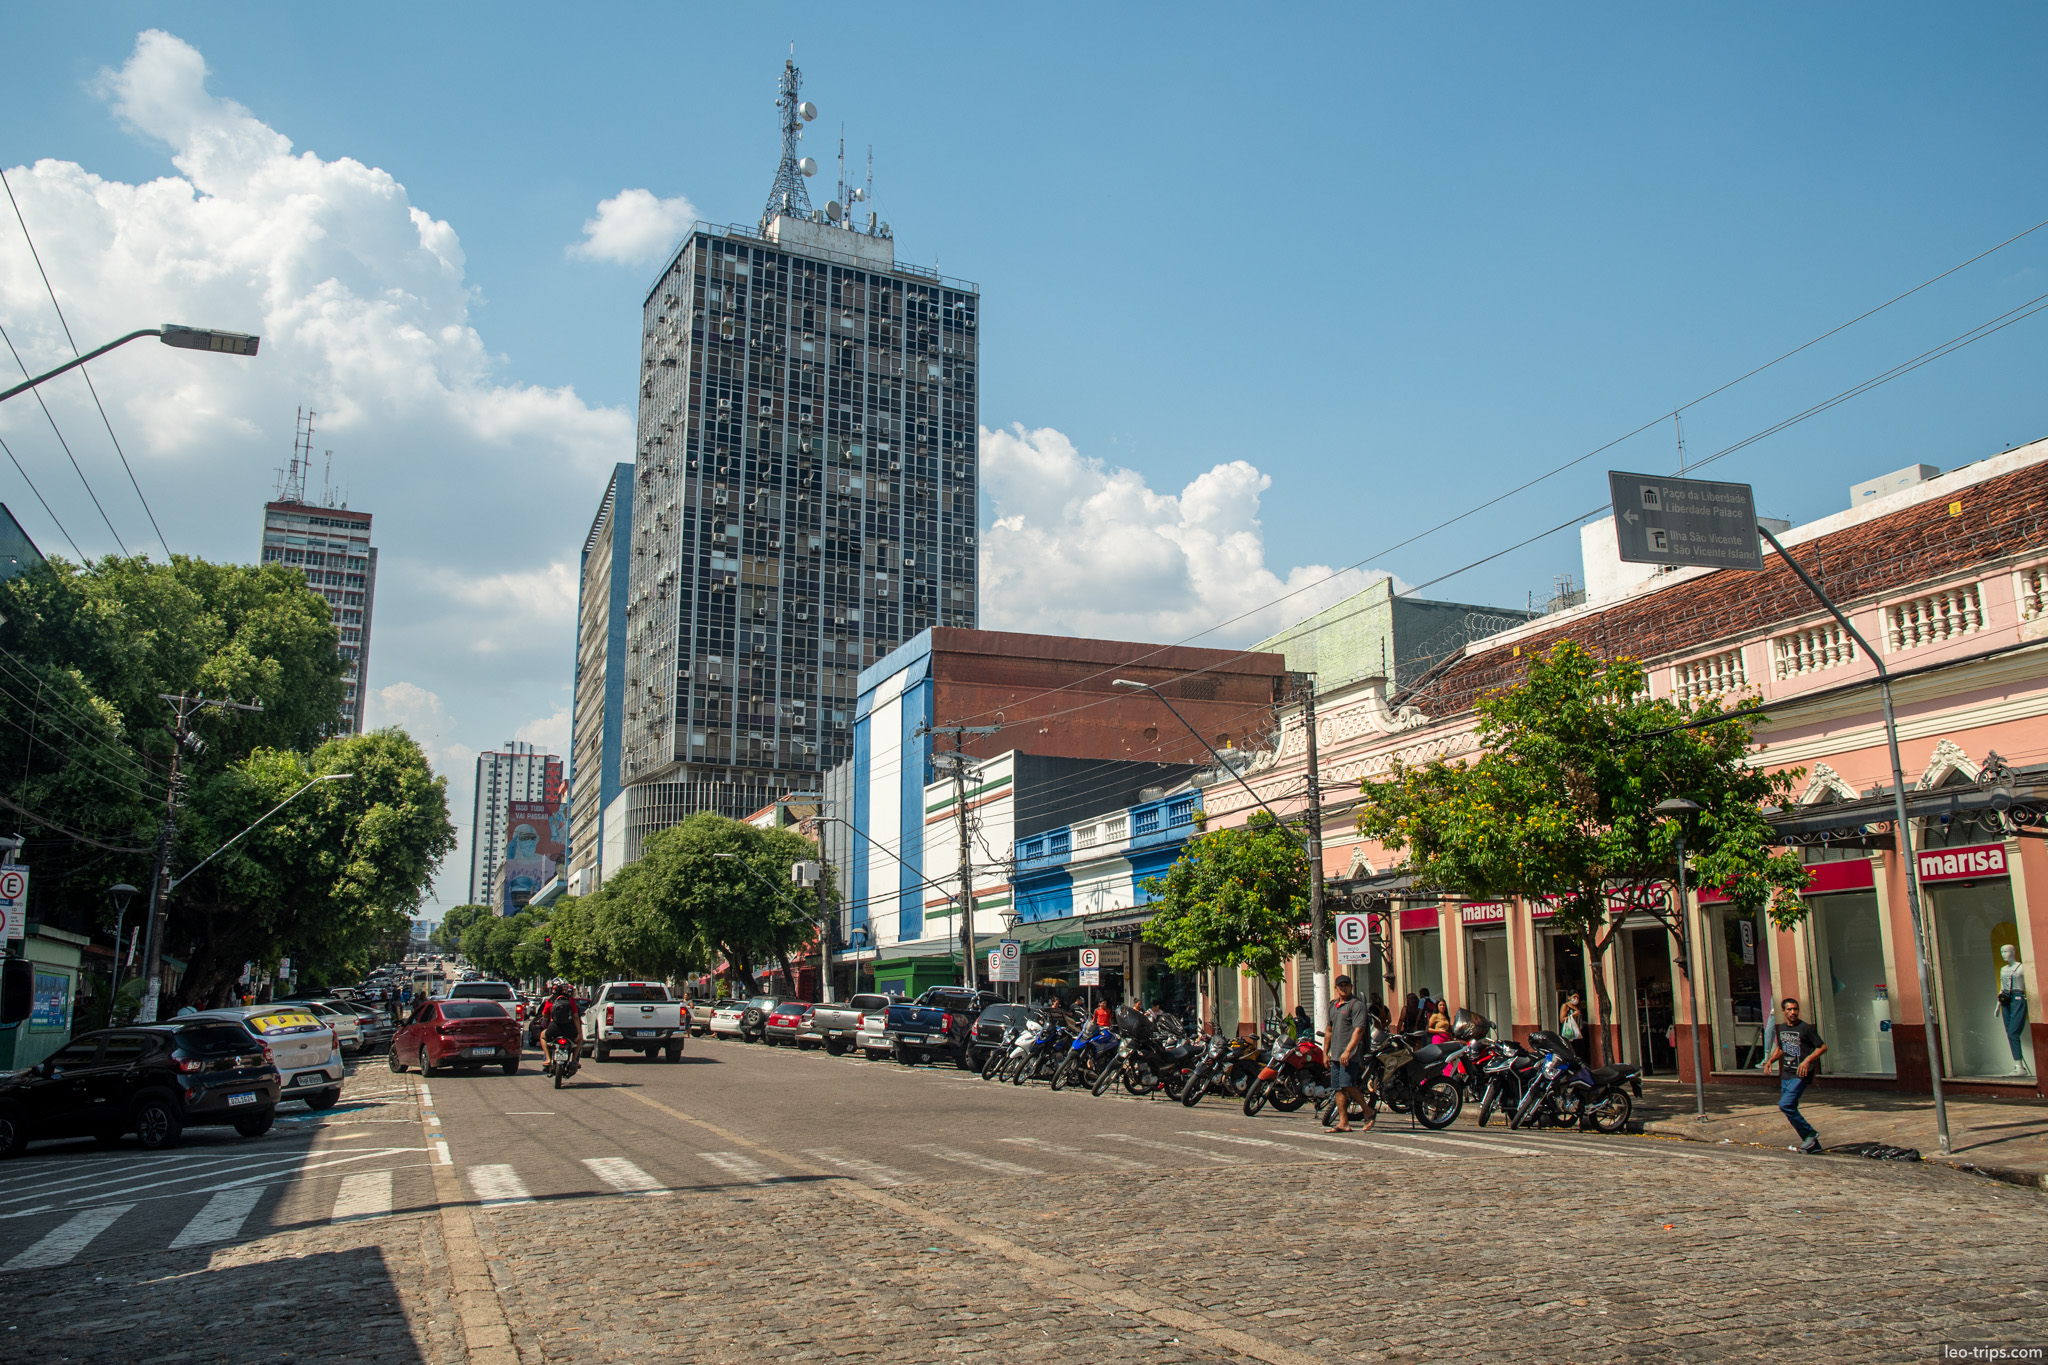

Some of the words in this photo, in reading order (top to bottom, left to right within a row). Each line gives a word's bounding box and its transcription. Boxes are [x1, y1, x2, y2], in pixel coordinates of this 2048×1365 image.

[1662, 488, 1685, 500] Paço
[1688, 490, 1698, 500] da
[1701, 491, 1746, 504] Liberdade
[1666, 502, 1711, 516] Liberdade
[1713, 506, 1743, 518] Palace
[1670, 530, 1688, 541] Ilha
[1690, 532, 1707, 542] São
[1708, 533, 1742, 546] Vicente
[1673, 544, 1691, 555] São
[1693, 546, 1726, 558] Vicente
[1728, 548, 1756, 560] Island
[1920, 849, 2004, 876] marisa
[6, 878, 17, 894] E
[1462, 904, 1504, 921] marisa
[1346, 922, 1358, 940] E
[1006, 947, 1013, 956] E
[1086, 953, 1092, 963] E
[993, 957, 998, 965] E
